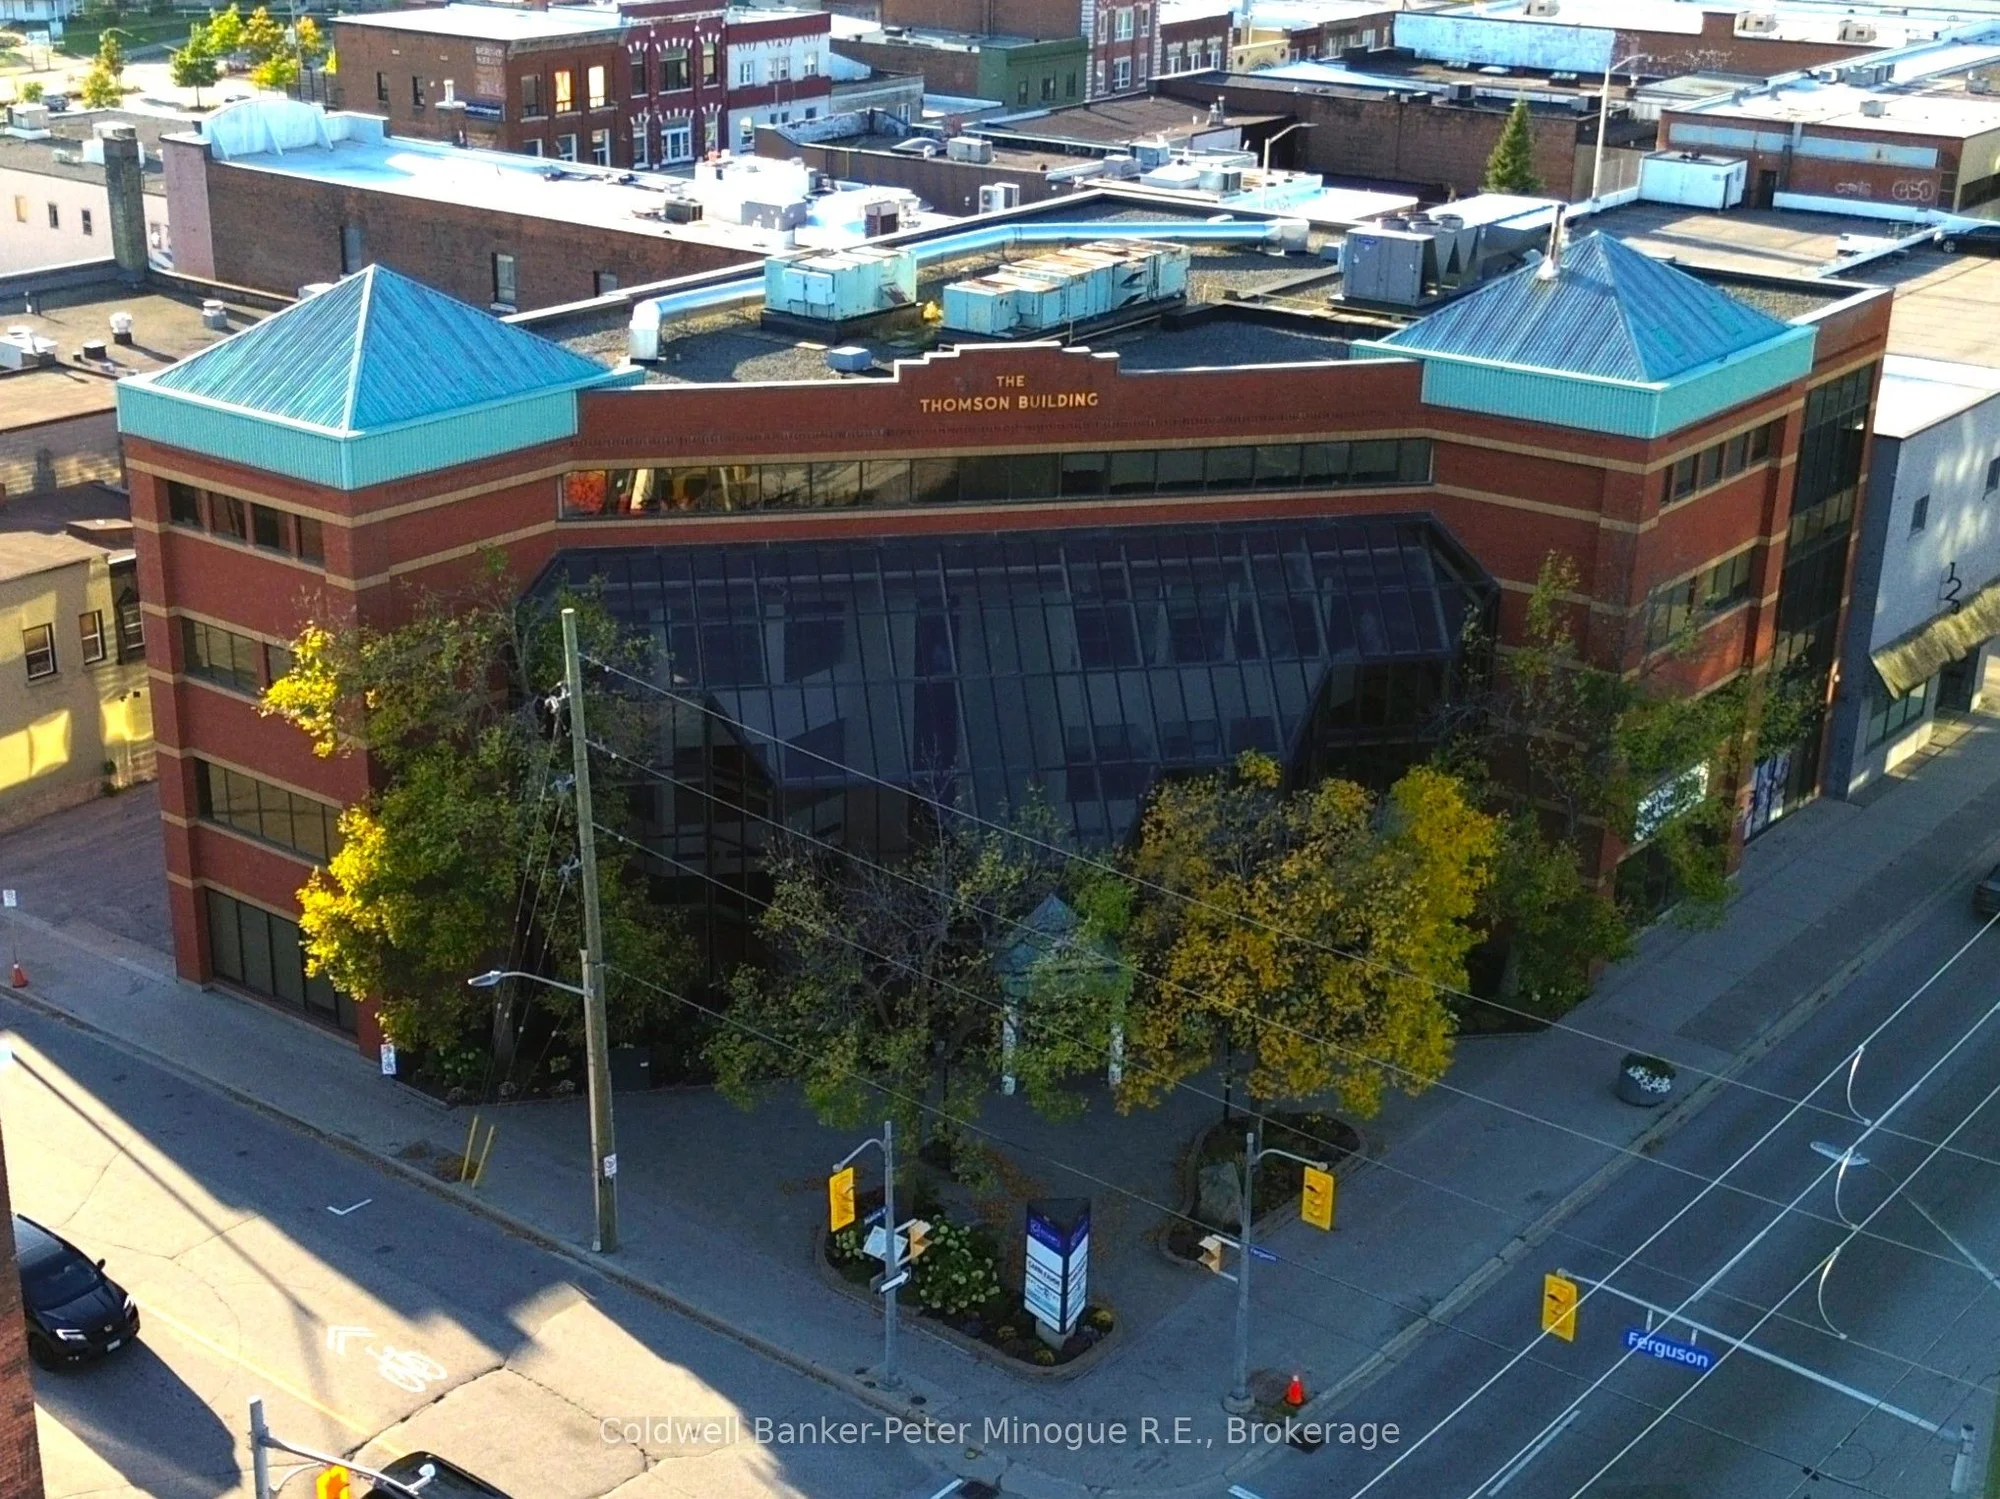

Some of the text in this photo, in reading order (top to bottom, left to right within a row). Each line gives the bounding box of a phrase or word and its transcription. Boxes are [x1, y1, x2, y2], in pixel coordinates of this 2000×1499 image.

[996, 375, 1025, 387] THE
[920, 392, 1099, 413] THOMSON BUILDING
[1627, 1331, 1709, 1368] Ferguson
